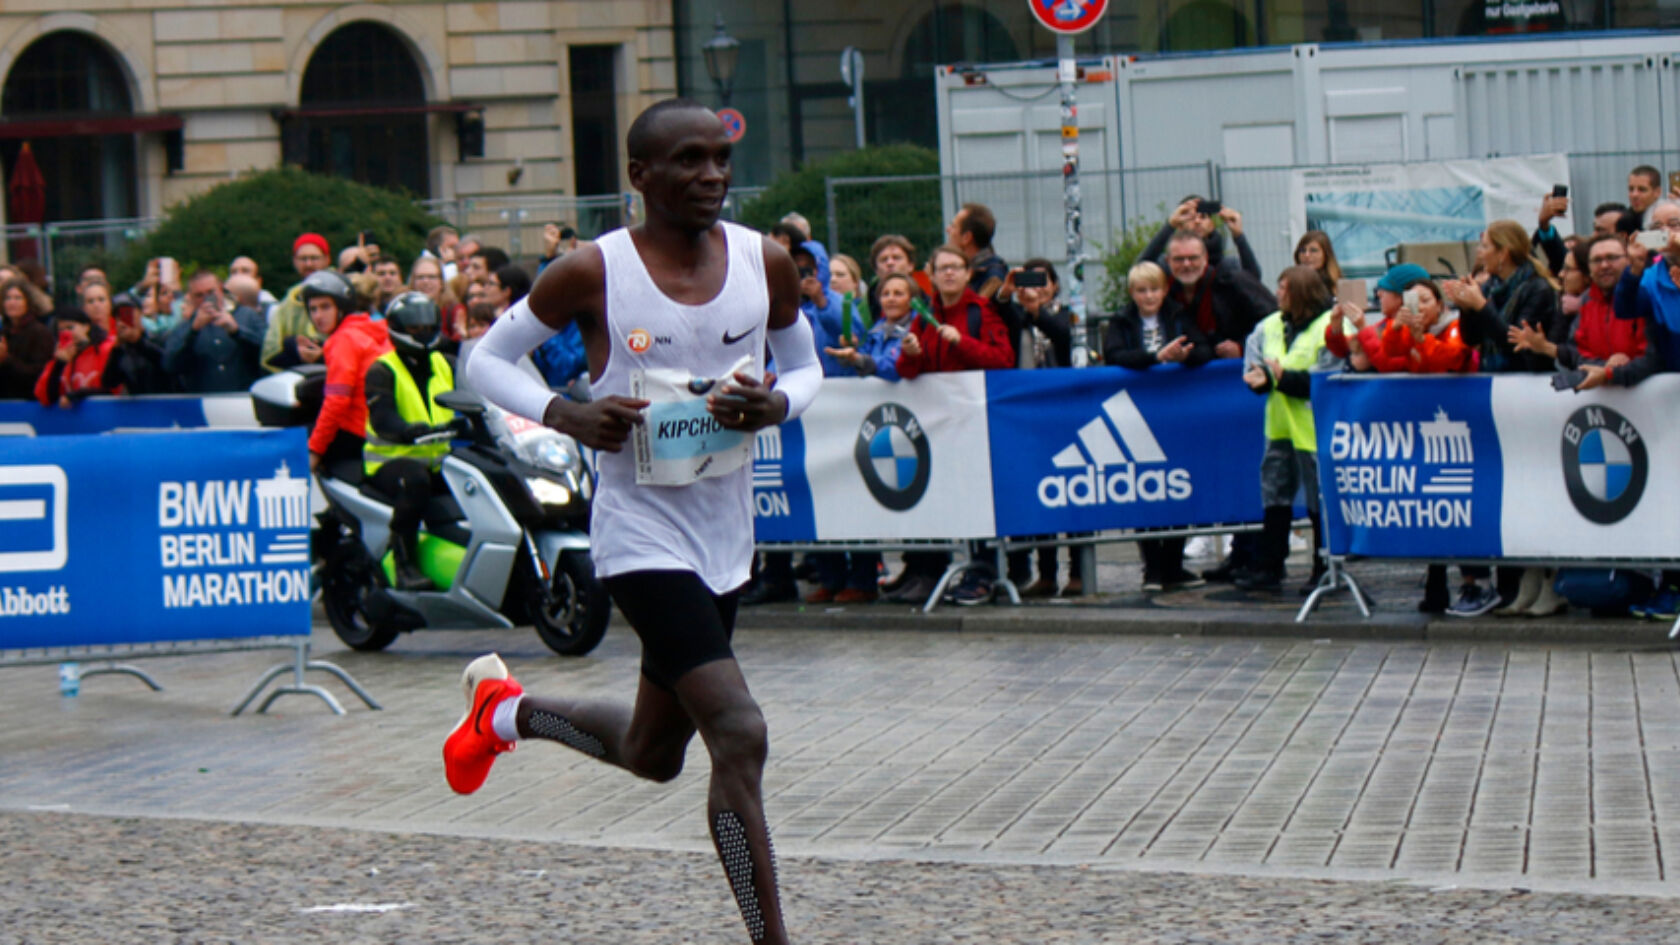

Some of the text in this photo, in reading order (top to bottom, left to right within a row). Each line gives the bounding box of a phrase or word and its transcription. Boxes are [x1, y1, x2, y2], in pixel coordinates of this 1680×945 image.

[654, 336, 671, 345] NN
[658, 417, 721, 439] KIPCHO
[862, 406, 922, 441] BMW
[1330, 421, 1414, 461] BMW
[1564, 406, 1638, 445] BMW
[1037, 462, 1193, 508] adidas
[1335, 465, 1417, 494] BERLIN
[159, 480, 251, 527] BMW
[1340, 499, 1472, 528] MARATHON
[160, 532, 256, 568] BERLIN
[163, 569, 310, 608] MARATHON
